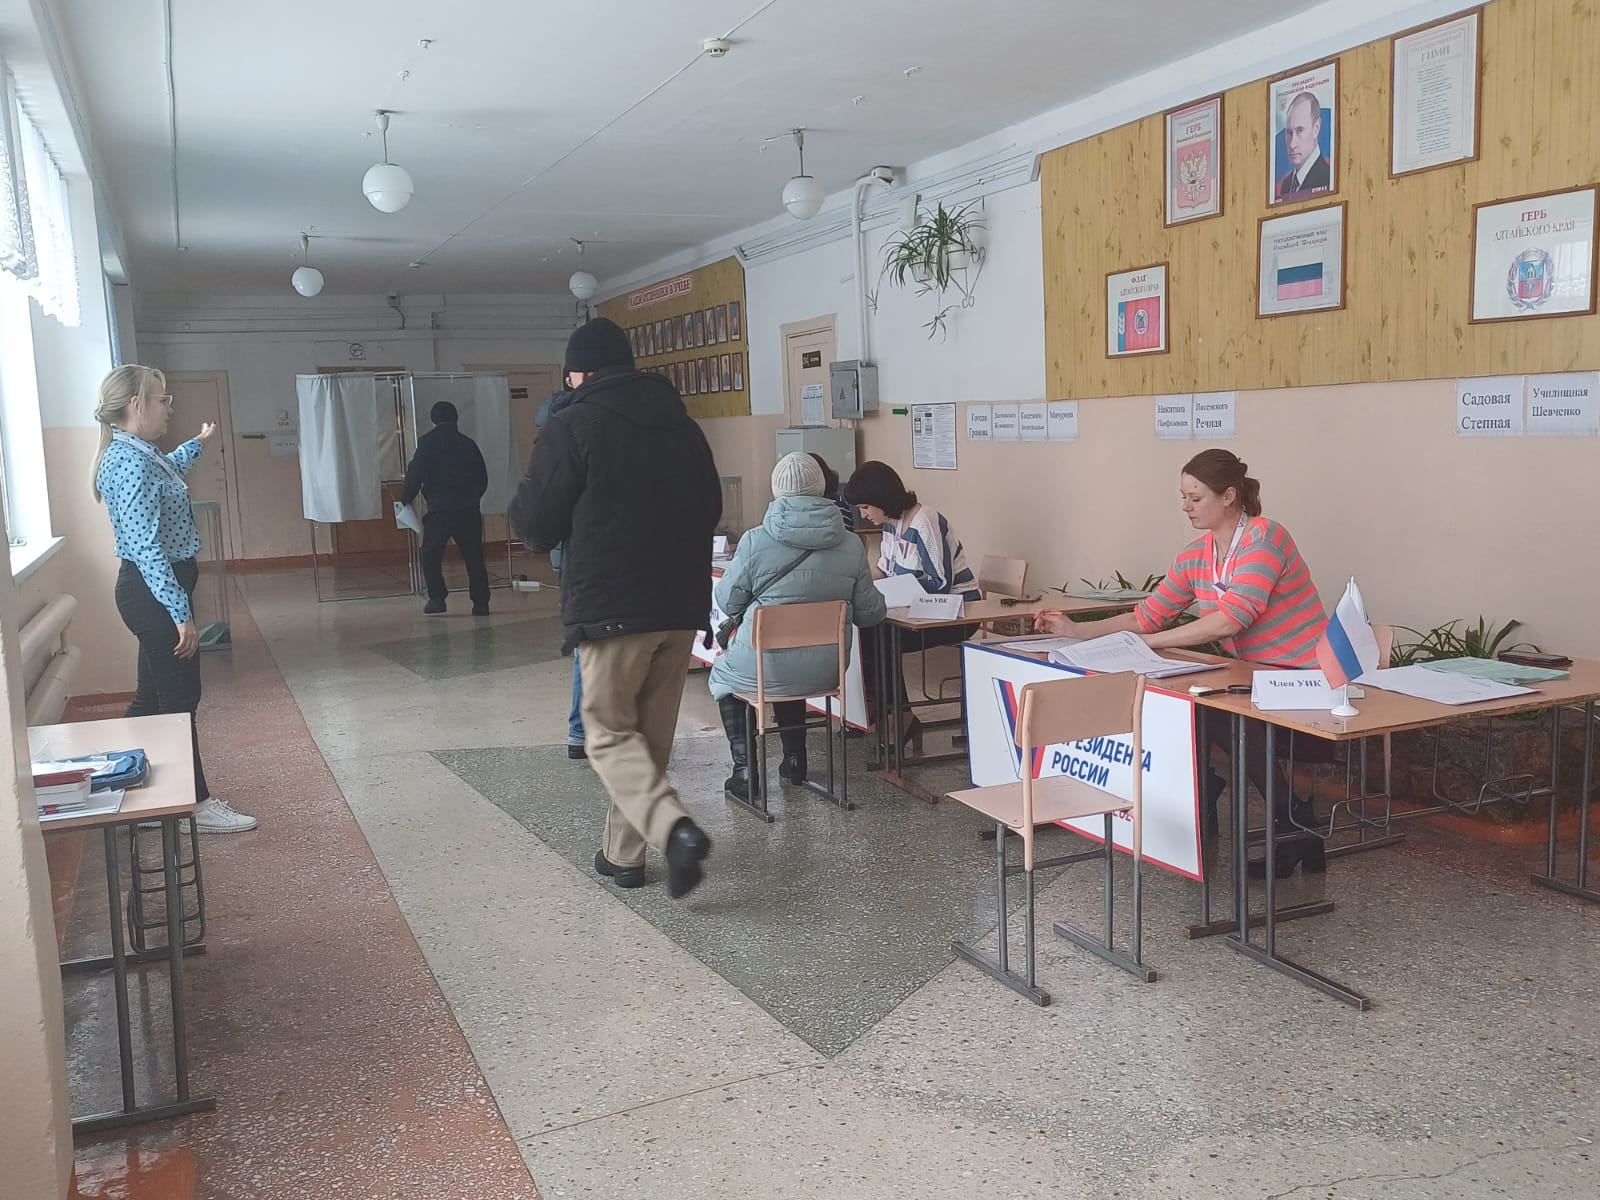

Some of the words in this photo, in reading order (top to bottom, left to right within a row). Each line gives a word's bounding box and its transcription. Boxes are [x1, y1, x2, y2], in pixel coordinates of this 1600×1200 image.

[1521, 209, 1547, 222] ГЕРБ
[1493, 224, 1551, 241] АЛТАЙСКОГО
[1552, 220, 1575, 233] КРАЯ
[1462, 392, 1511, 406] Садовая
[1532, 387, 1588, 399] Училищная
[1532, 406, 1581, 417] Шевченко
[1195, 417, 1222, 428] Речная
[1461, 416, 1511, 429] Степная
[1269, 679, 1294, 687] Член
[1296, 679, 1322, 688] УИК
[1051, 751, 1110, 787] РОССИИ
